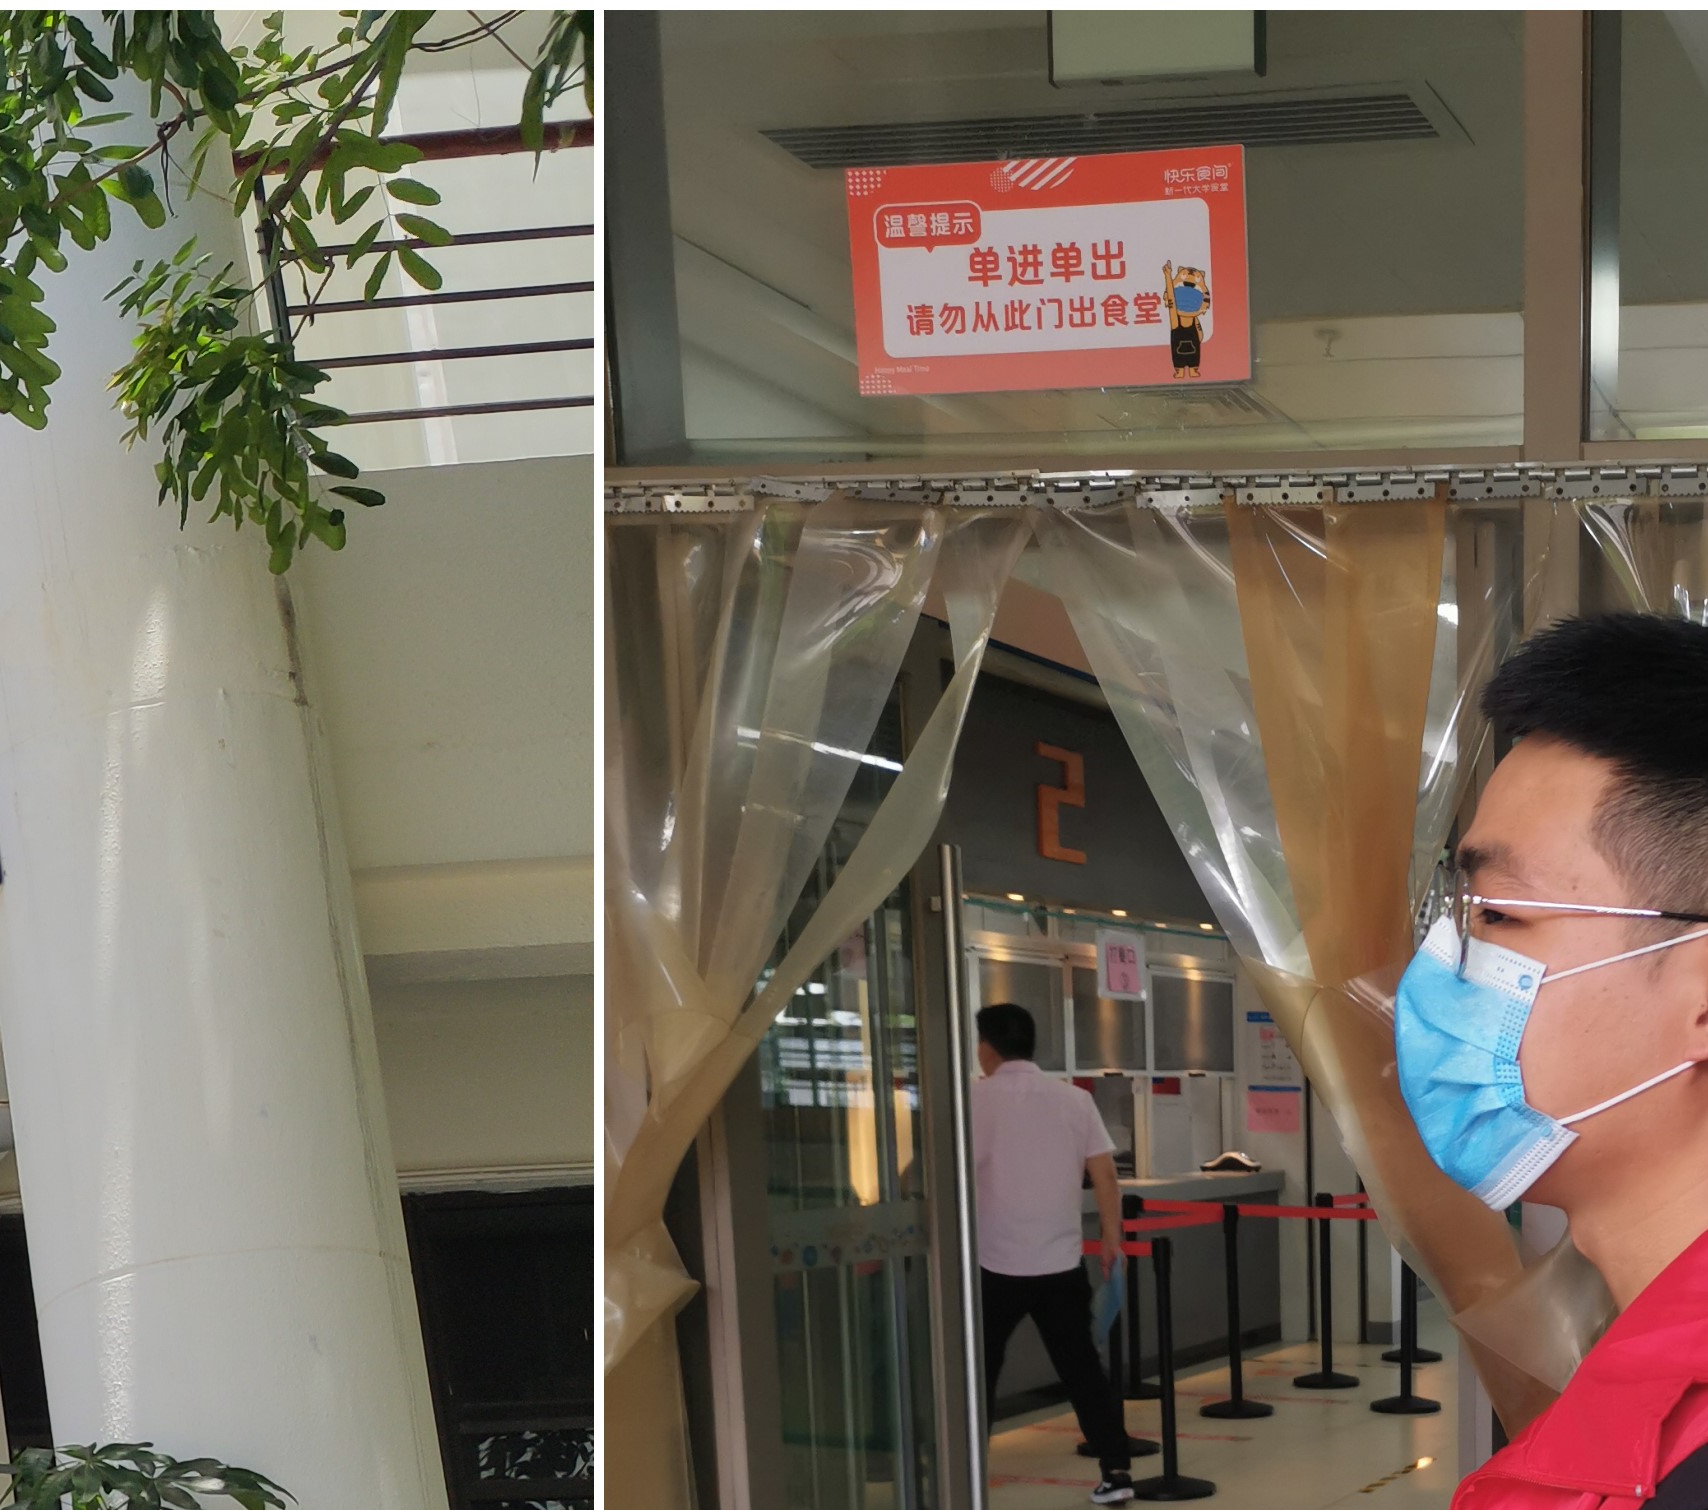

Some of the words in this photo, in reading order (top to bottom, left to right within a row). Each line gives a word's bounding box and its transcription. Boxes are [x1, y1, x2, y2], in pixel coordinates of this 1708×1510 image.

[884, 211, 974, 239] 温馨提示
[968, 240, 1126, 287] 单进单出
[906, 292, 1162, 336] 请勿从此门出食堂
[1036, 741, 1087, 863] 2
